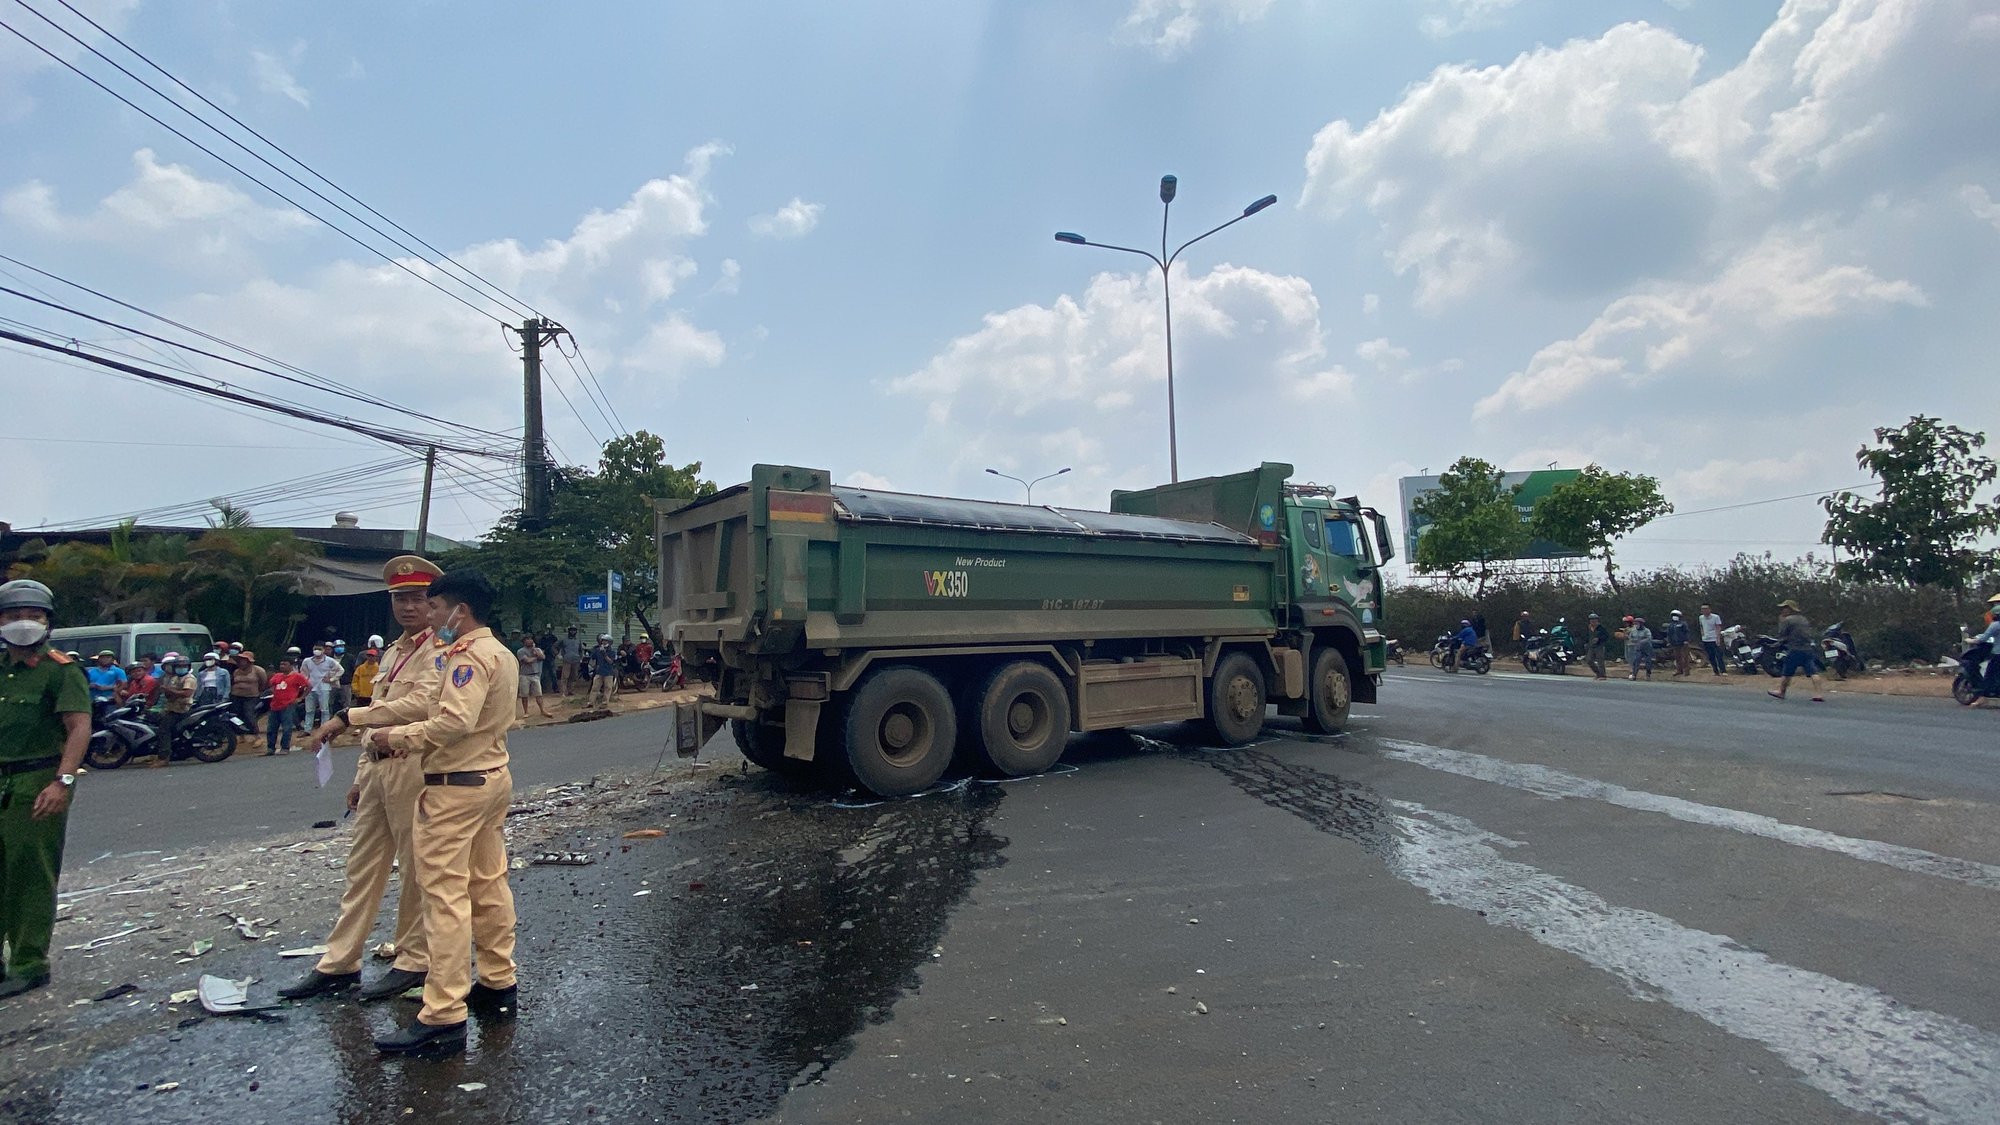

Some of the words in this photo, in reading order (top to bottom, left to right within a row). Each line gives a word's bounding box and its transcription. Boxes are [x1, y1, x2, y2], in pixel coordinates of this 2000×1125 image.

[955, 556, 973, 567] New
[974, 557, 1006, 568] Product
[923, 570, 968, 597] VX350
